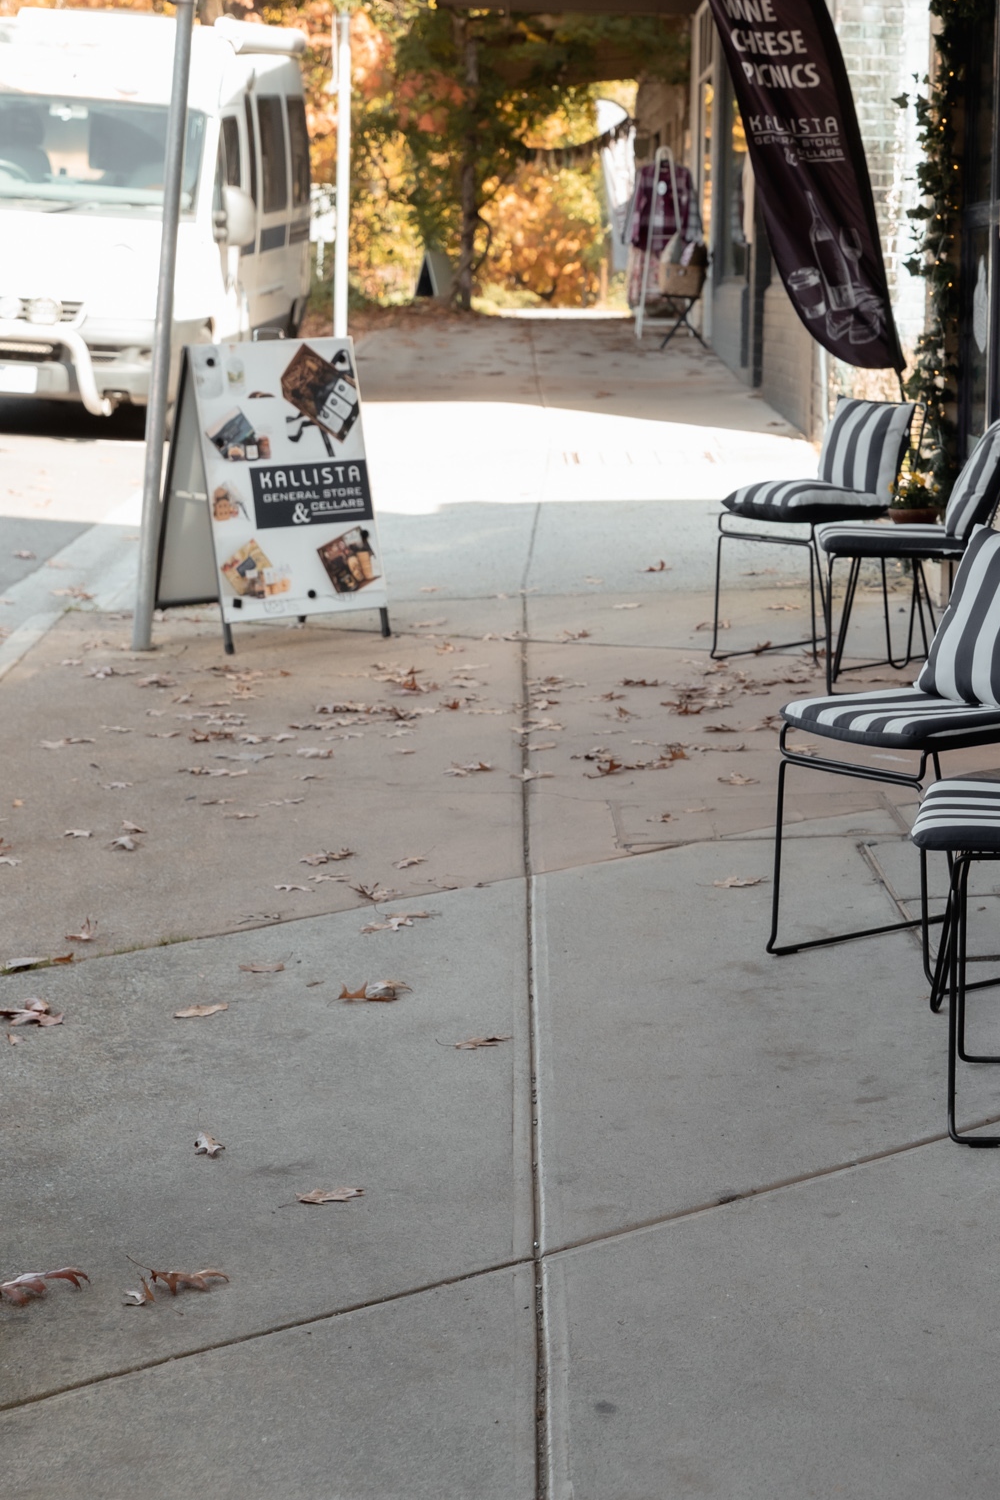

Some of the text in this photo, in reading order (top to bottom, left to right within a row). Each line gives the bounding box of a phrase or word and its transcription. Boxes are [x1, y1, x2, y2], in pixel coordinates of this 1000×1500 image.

[730, 28, 807, 56] CHEESE
[741, 61, 820, 89] PICNICS
[749, 114, 838, 133] KALISTA
[259, 465, 361, 489] KALLISTA
[263, 486, 362, 503] GENERAL STORE
[292, 498, 364, 524] & CELLARS
